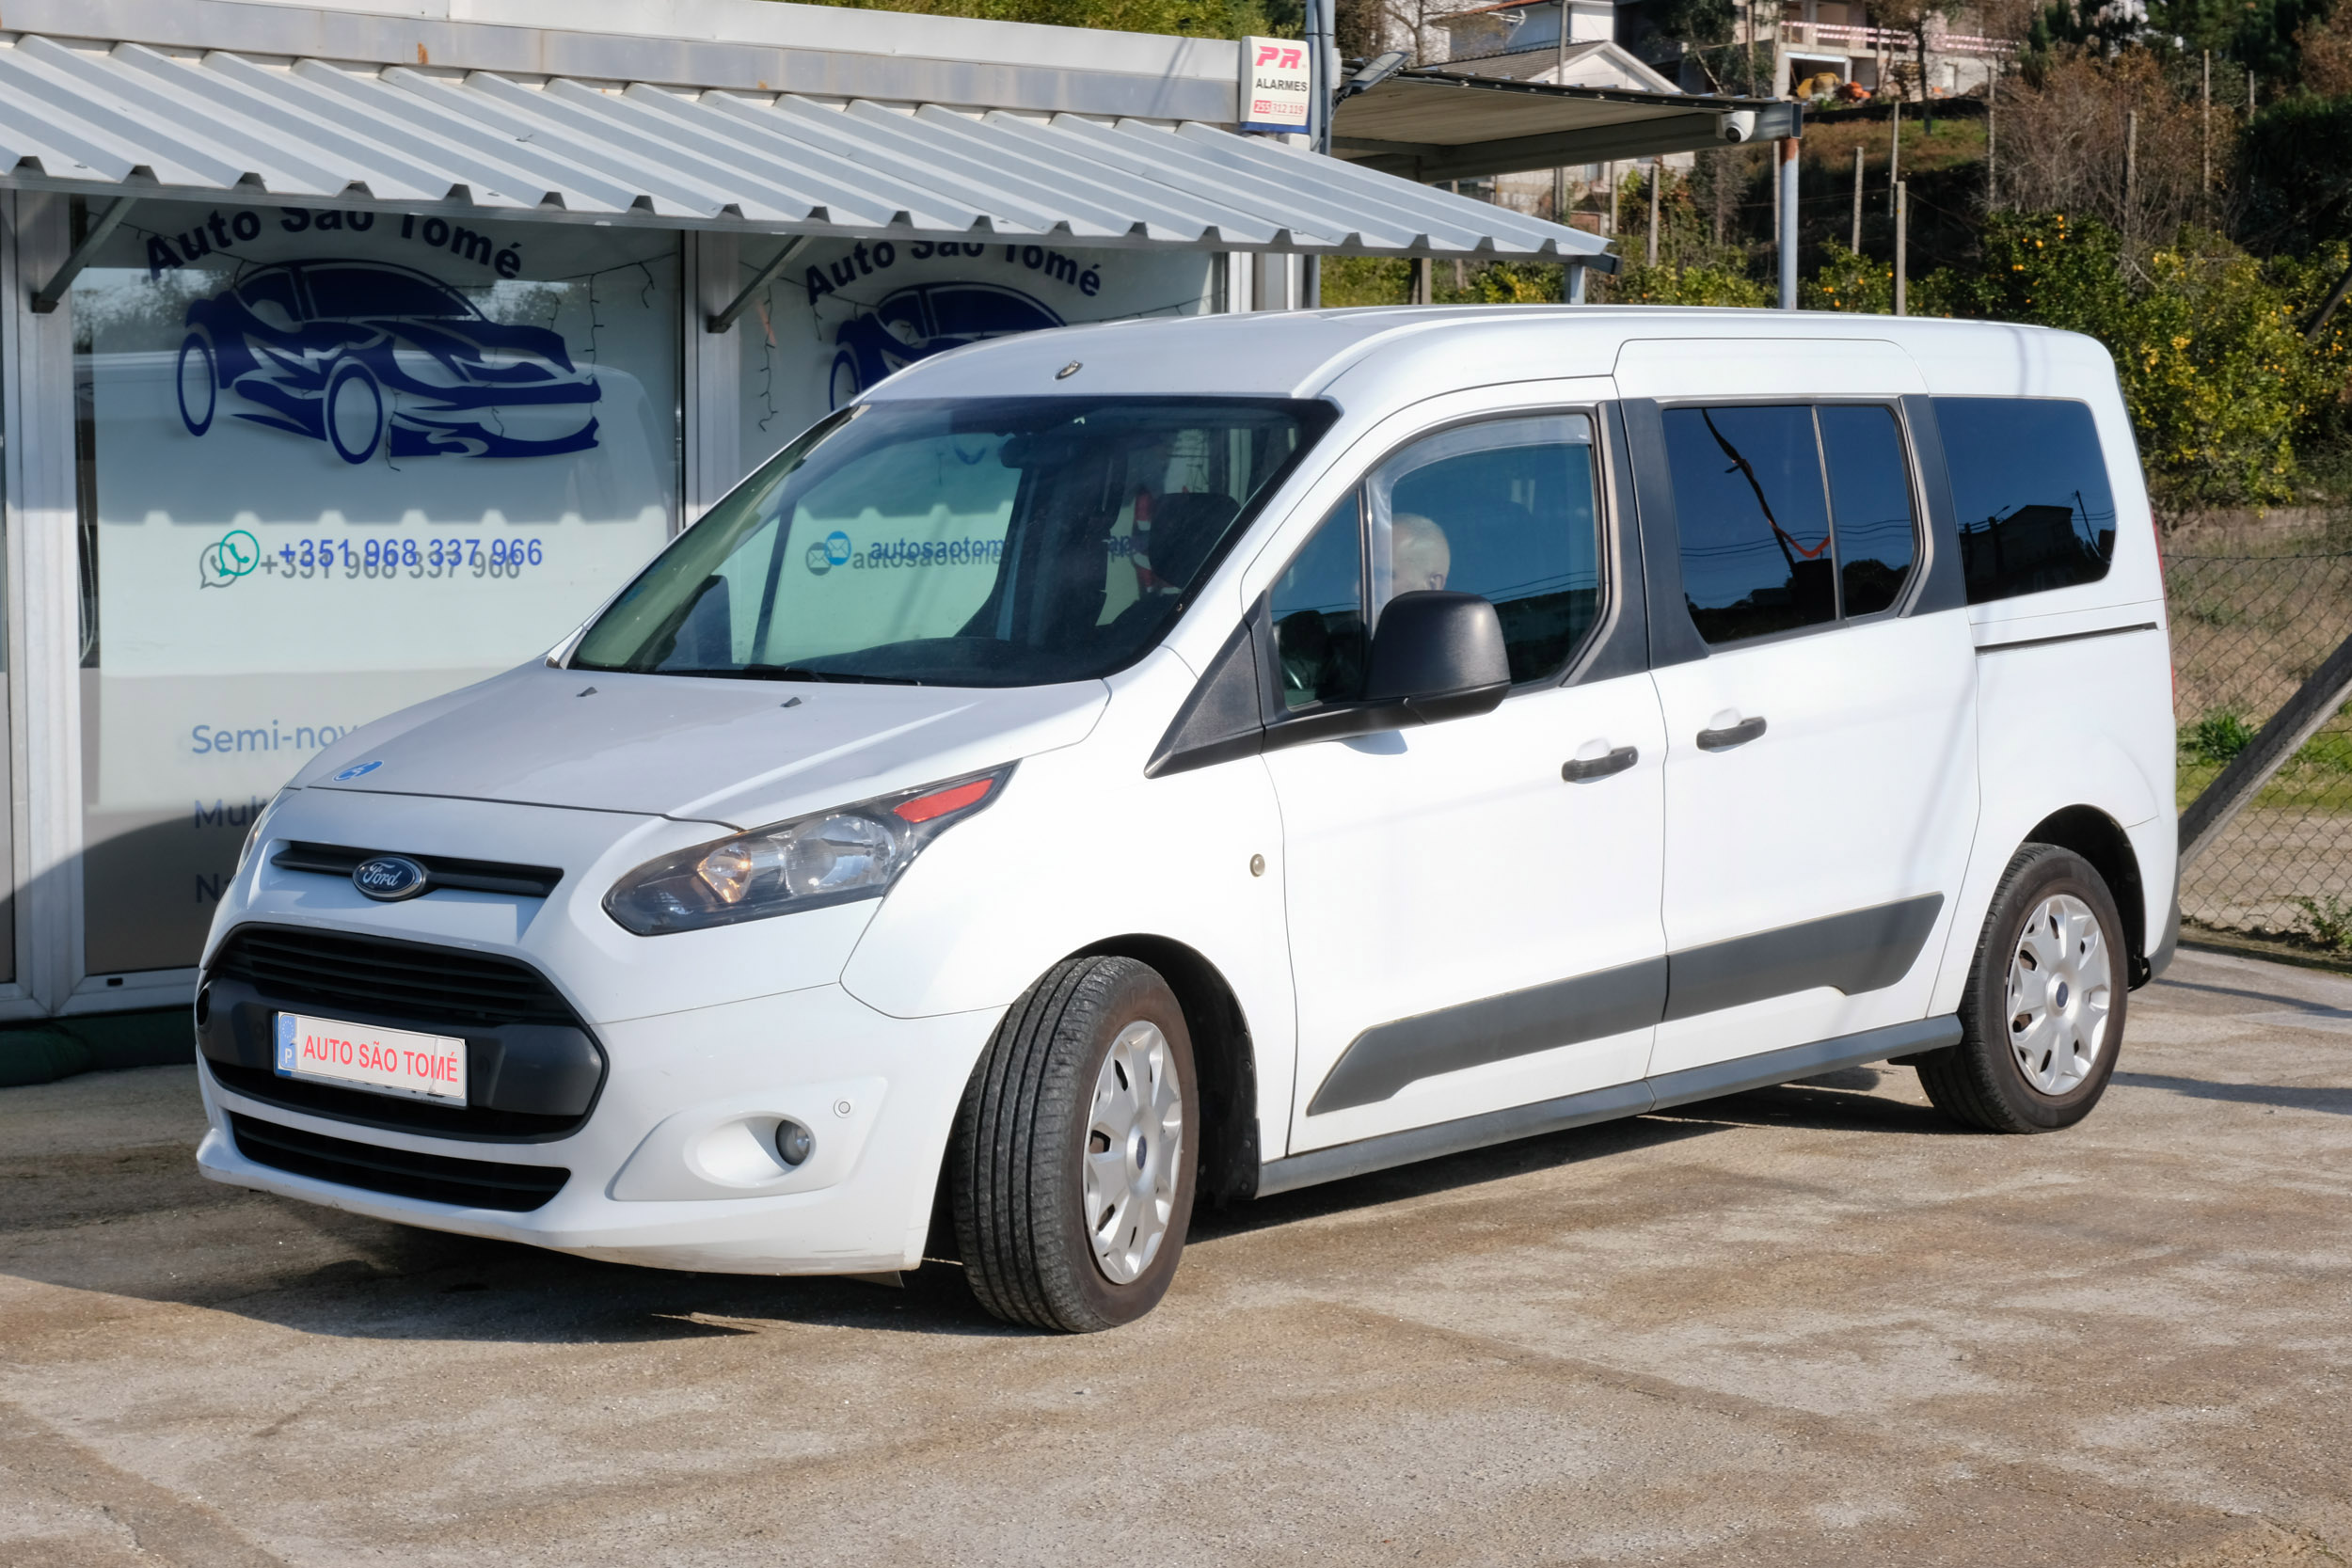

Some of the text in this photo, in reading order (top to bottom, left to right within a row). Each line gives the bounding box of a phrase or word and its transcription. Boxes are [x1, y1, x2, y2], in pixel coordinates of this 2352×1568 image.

[1255, 45, 1302, 69] PR
[1255, 78, 1308, 92] ALARMES
[146, 209, 261, 281] Auto
[805, 241, 896, 306] Auto
[278, 539, 543, 567] +351 968 337 966
[870, 536, 1006, 561] autosaotom
[362, 862, 403, 887] Ford
[285, 1048, 293, 1064] P
[303, 1035, 458, 1083] AUTO SÃO TOMÉ
